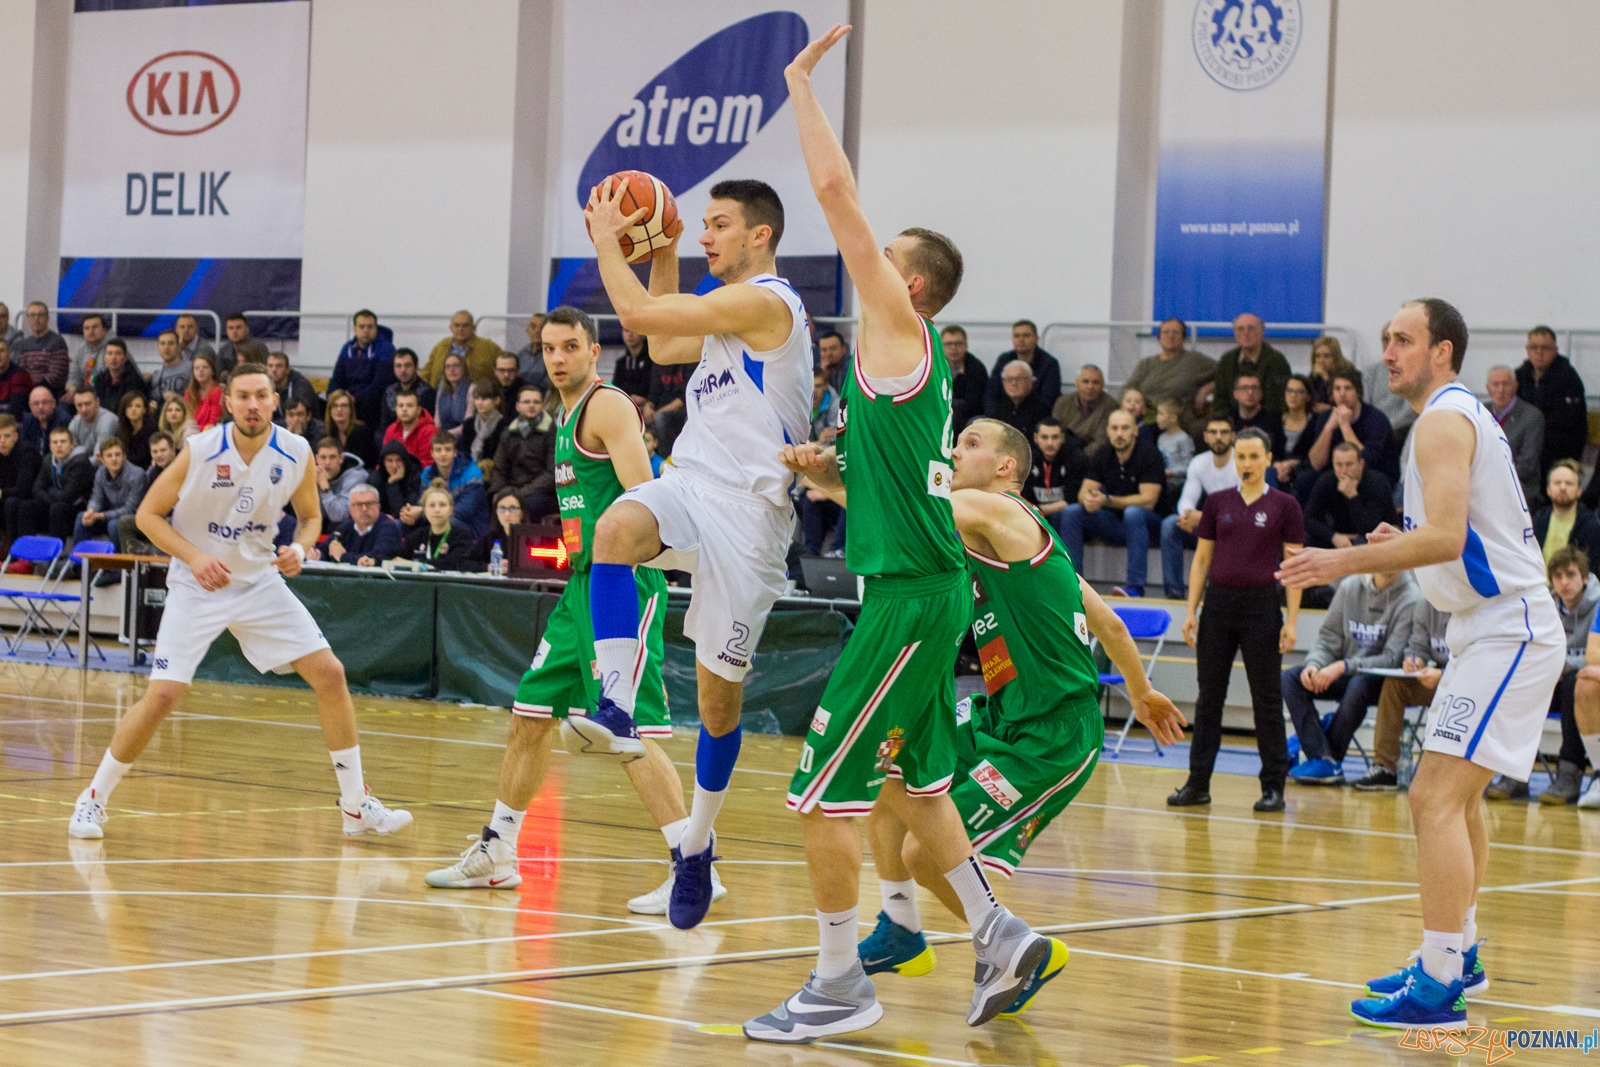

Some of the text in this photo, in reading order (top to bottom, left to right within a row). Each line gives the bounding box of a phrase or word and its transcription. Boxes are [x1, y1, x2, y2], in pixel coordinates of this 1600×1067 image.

[147, 70, 219, 116] KIA
[616, 85, 763, 148] atrem
[126, 171, 231, 216] DELIK
[726, 620, 750, 658] 2
[1437, 694, 1476, 733] 12
[967, 803, 995, 831] 11
